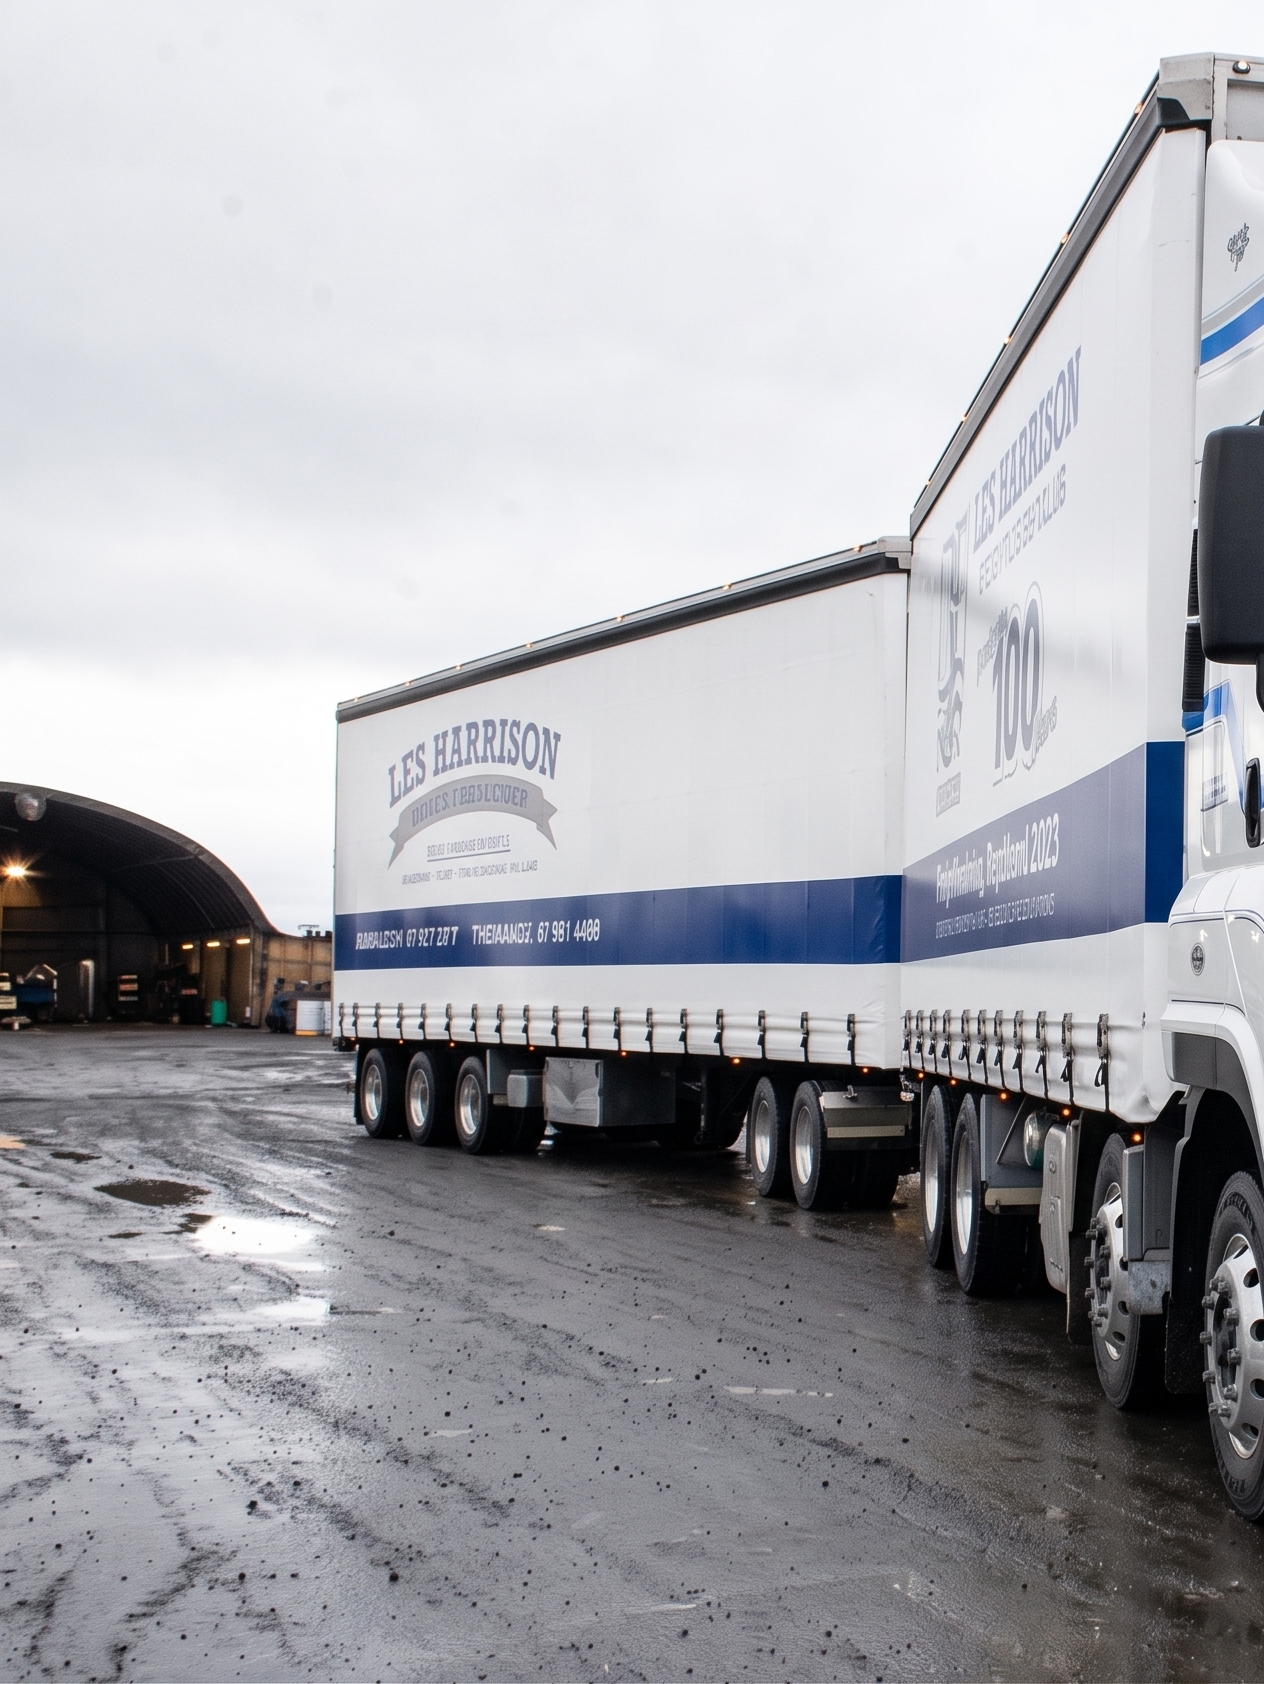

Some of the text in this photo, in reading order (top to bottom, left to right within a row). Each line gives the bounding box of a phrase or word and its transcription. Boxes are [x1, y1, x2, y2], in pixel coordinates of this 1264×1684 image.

[973, 467, 996, 554] LES
[998, 345, 1082, 524] HARRISON
[992, 597, 1040, 771] 100
[388, 741, 426, 809] LES
[432, 718, 562, 781] HARRISON
[1030, 812, 1060, 874] 2023
